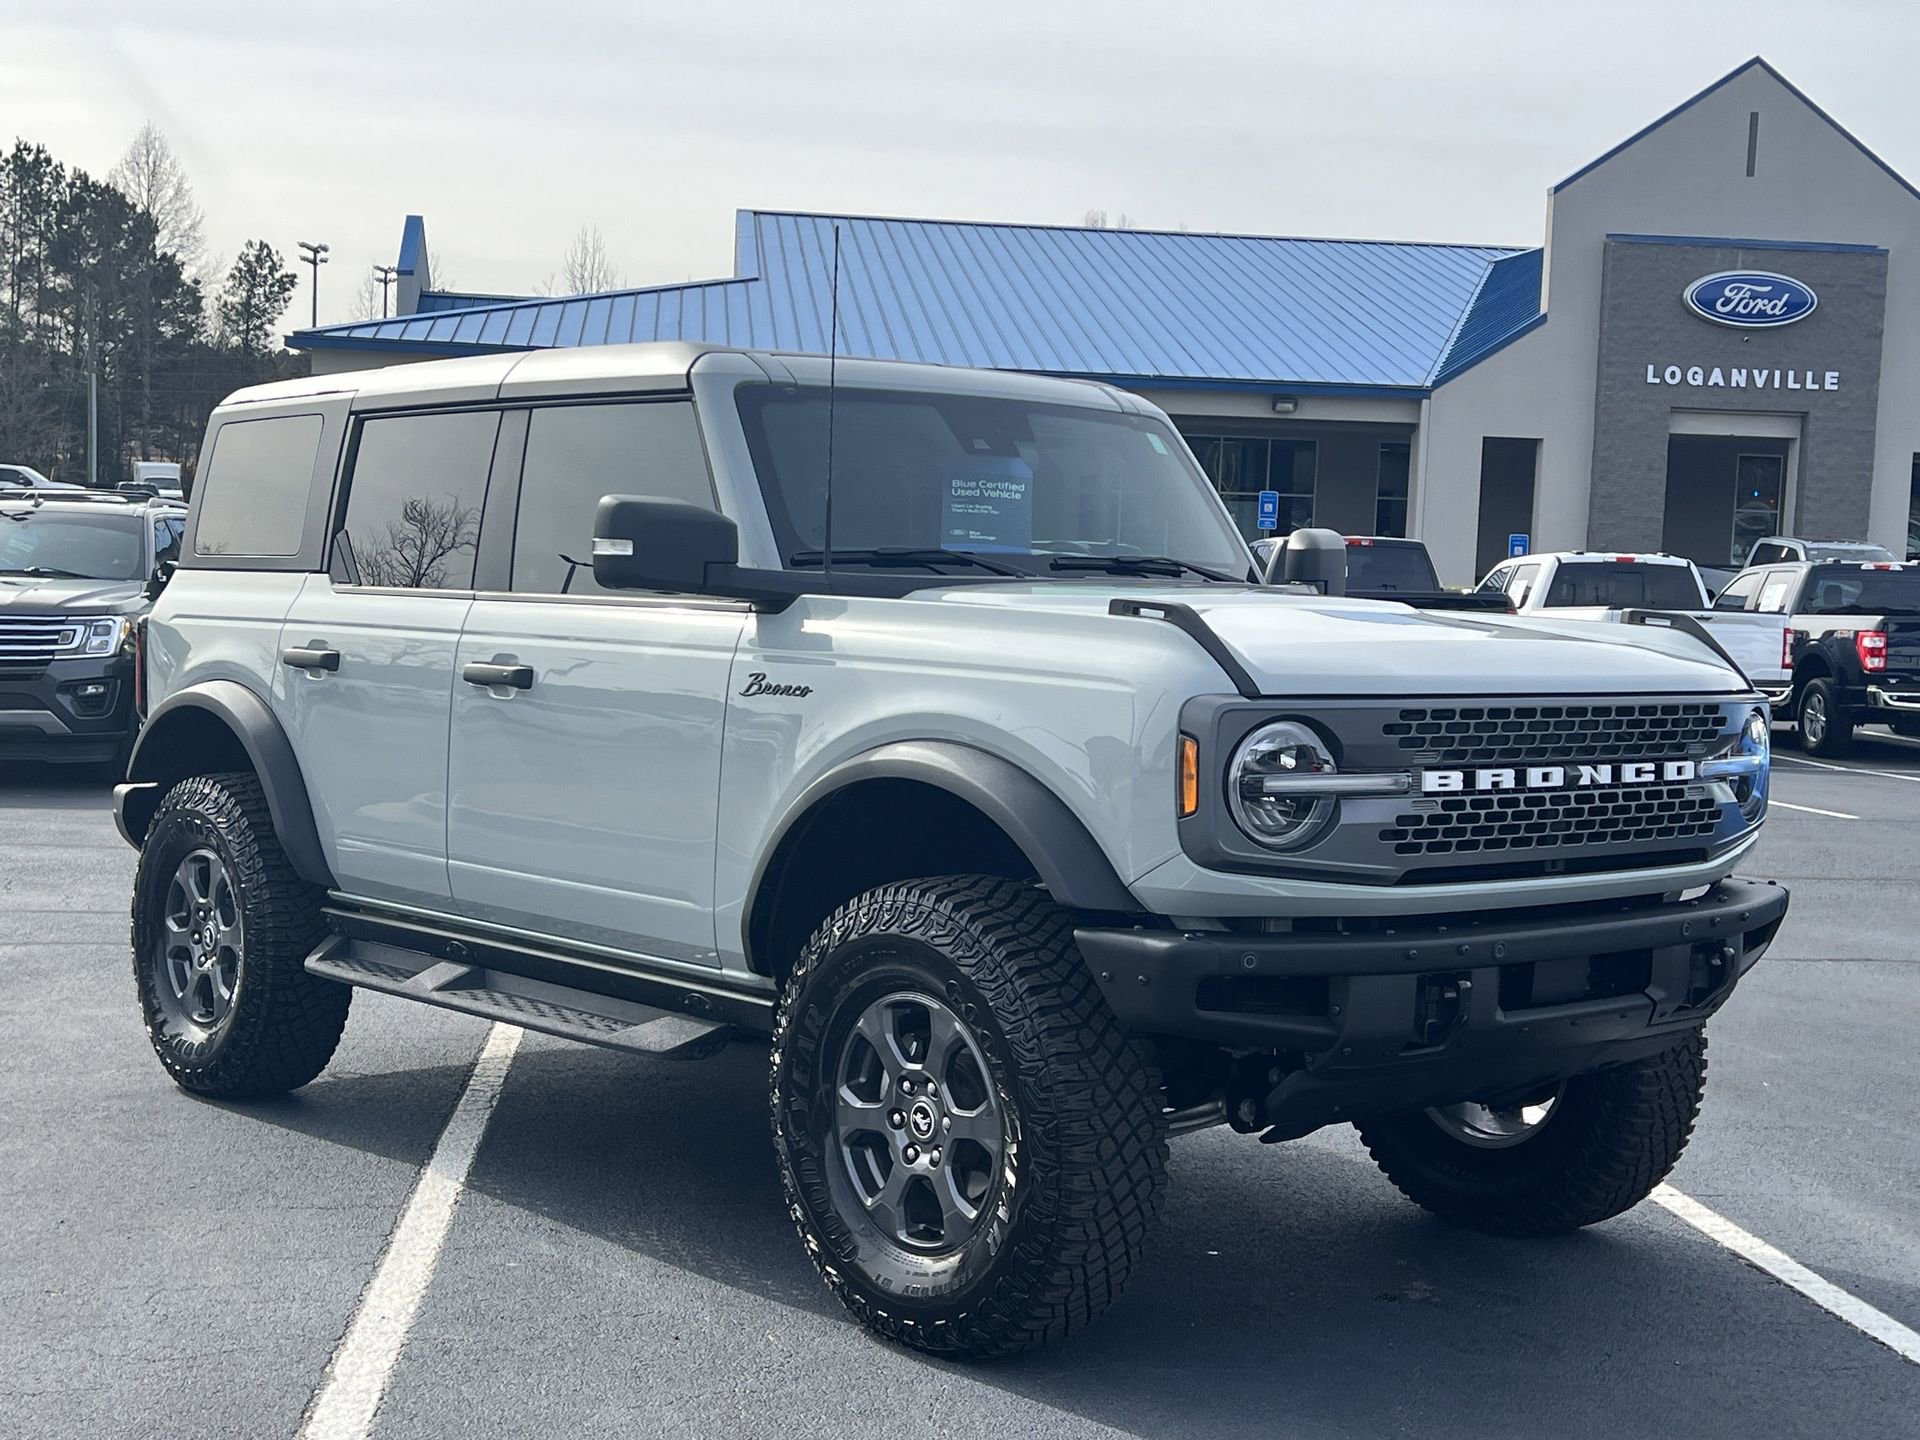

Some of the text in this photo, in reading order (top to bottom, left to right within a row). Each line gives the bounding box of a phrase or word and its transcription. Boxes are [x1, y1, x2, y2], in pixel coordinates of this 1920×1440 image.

[1715, 282, 1790, 315] Ford
[1646, 364, 1840, 391] LOGANVILLE
[951, 488, 1022, 500] Used Vehicle
[952, 479, 1025, 492] Blue Certified
[738, 672, 814, 698] Bronco
[1421, 760, 1695, 792] BRONCO
